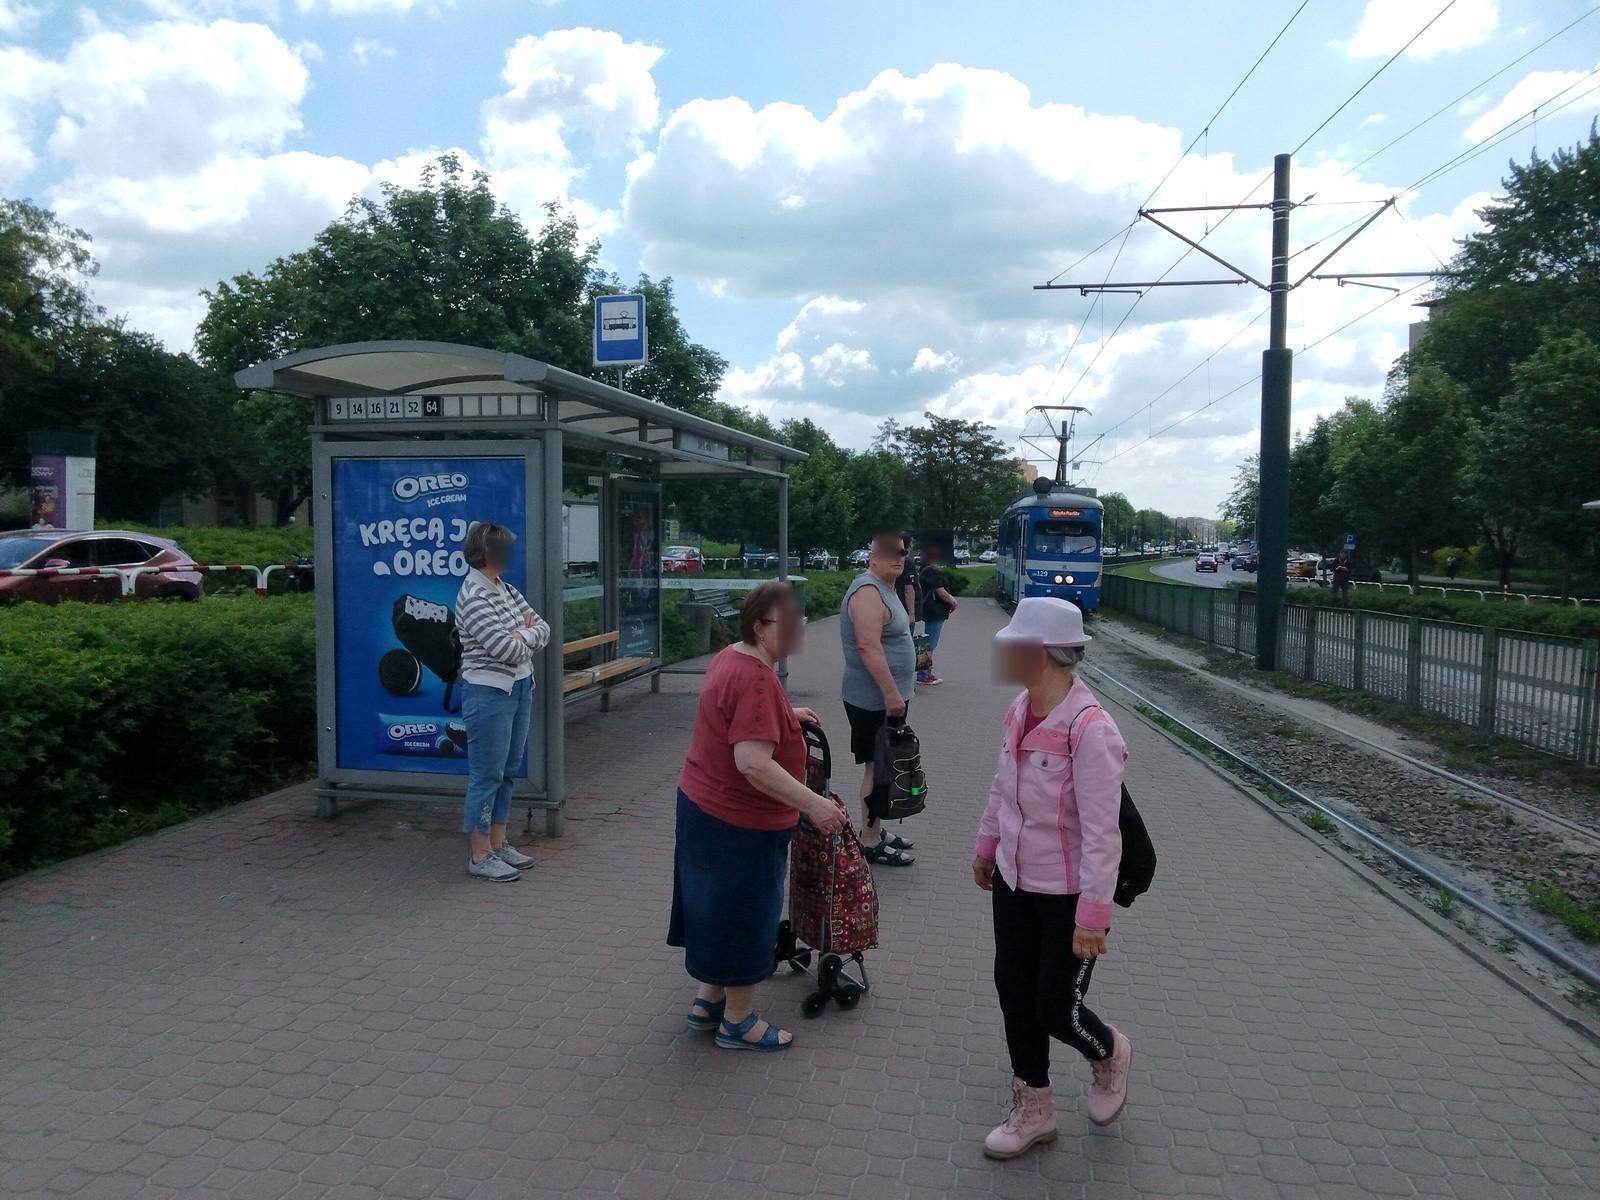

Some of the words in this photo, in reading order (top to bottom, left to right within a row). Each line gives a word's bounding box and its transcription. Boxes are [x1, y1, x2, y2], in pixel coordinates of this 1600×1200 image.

[336, 403, 342, 414] 9
[352, 403, 363, 414] 14
[371, 402, 381, 413] 16
[390, 402, 400, 413] 21
[408, 401, 419, 413] 52
[426, 401, 437, 412] 64
[394, 473, 468, 499] OREO
[427, 497, 441, 508] ICE
[440, 493, 467, 503] CREAM
[359, 517, 445, 548] KRĘCĄ
[393, 549, 471, 577] OREO
[389, 722, 437, 740] OREO
